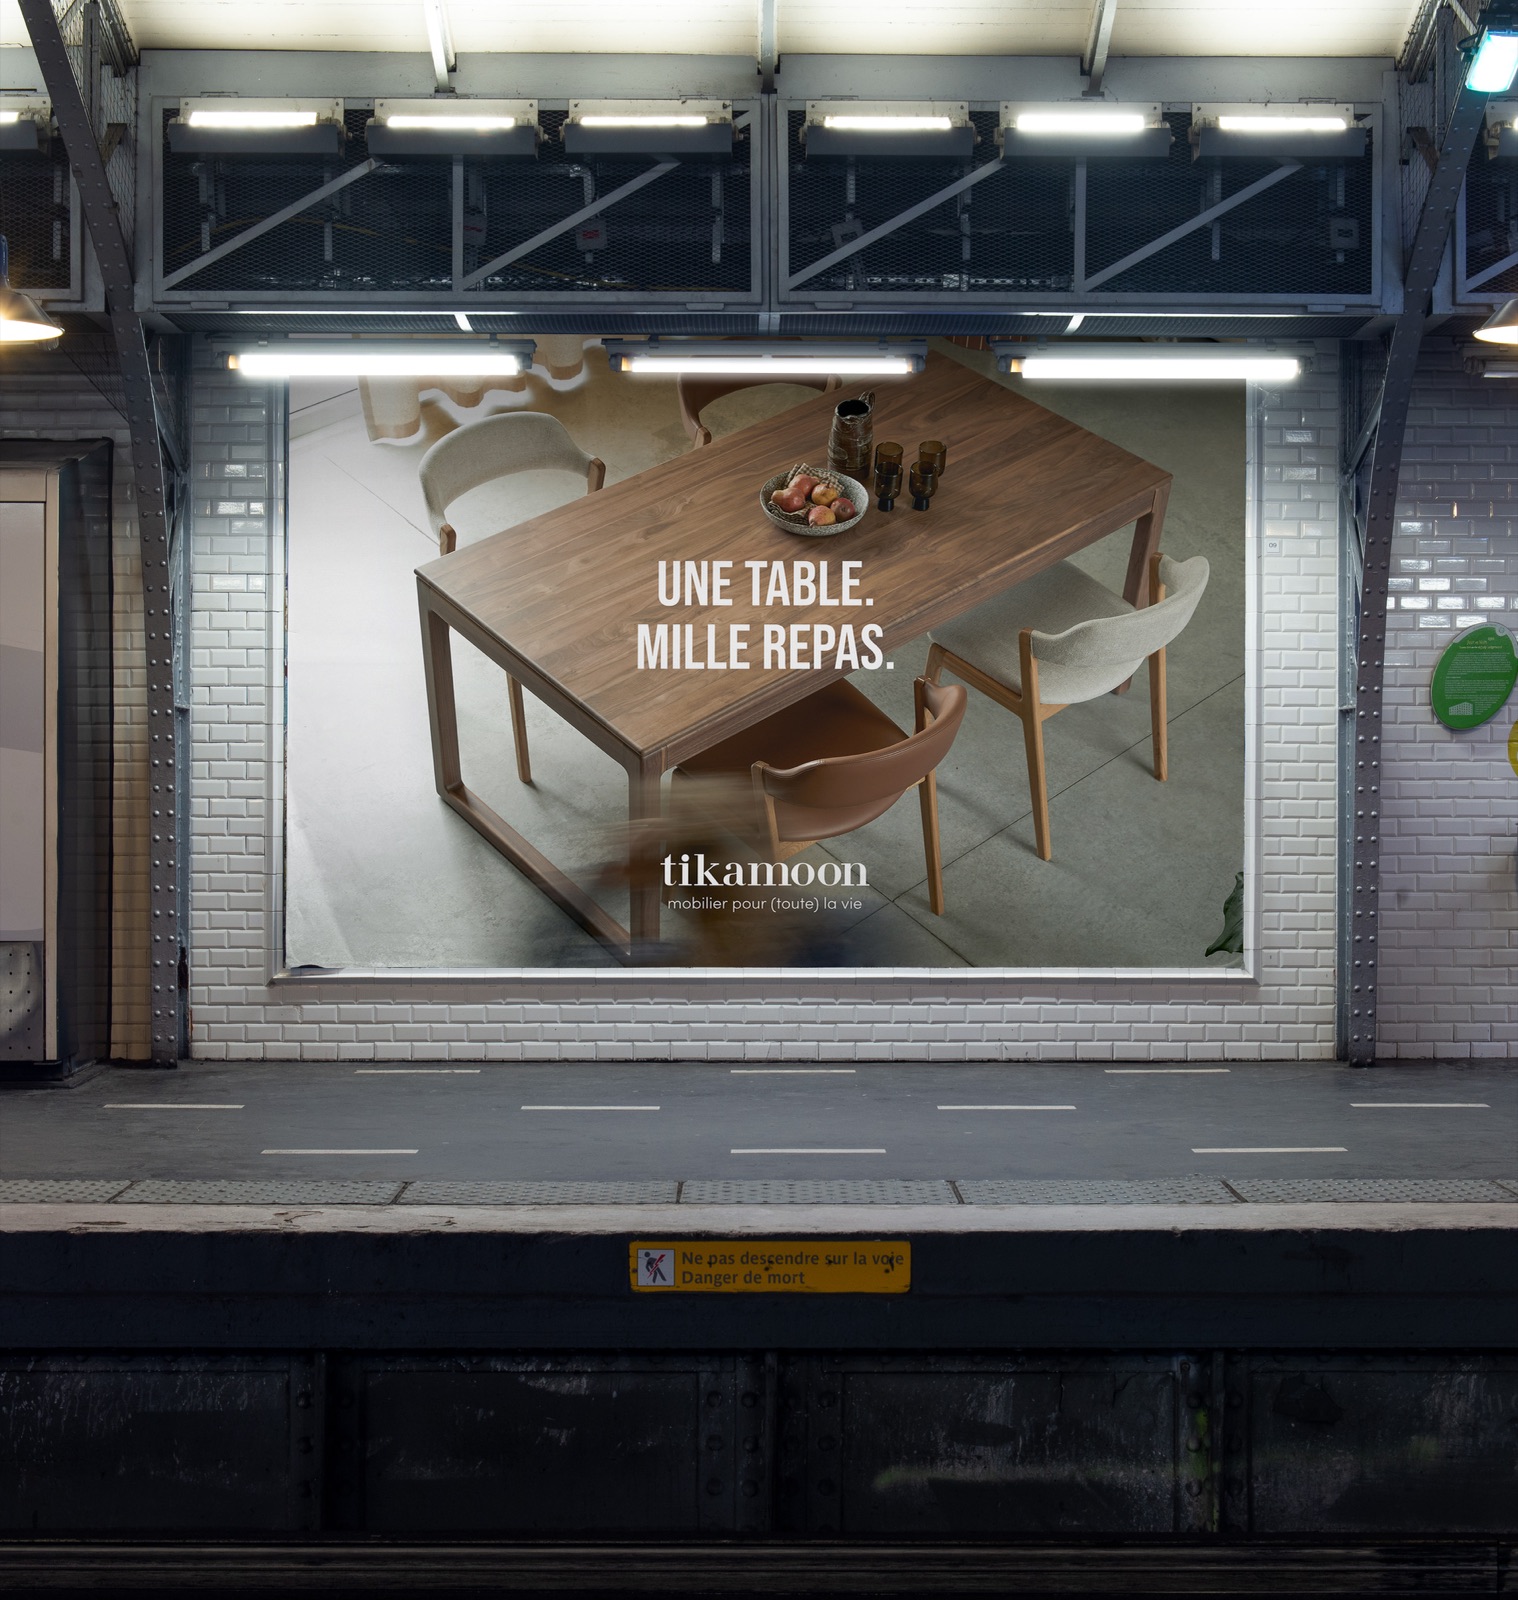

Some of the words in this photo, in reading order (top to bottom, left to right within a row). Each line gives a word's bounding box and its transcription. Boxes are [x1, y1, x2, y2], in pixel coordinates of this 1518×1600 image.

[658, 560, 733, 607] UNE
[745, 560, 874, 606] TABLE.
[637, 624, 750, 670] MILLE
[763, 623, 895, 670] REPAS.
[660, 853, 870, 887] tikamoon
[667, 896, 728, 910] mobilier
[732, 899, 767, 912] pour
[770, 896, 819, 912] (toute)
[823, 896, 837, 910] la
[841, 897, 863, 910] vie
[681, 1252, 703, 1265] Ne
[709, 1255, 735, 1269] pas
[741, 1251, 819, 1266] descendre
[825, 1254, 848, 1266] sur
[853, 1251, 867, 1266] la
[873, 1252, 904, 1267] voie
[681, 1271, 738, 1287] Danger
[743, 1270, 762, 1284] de
[767, 1272, 805, 1284] mort
